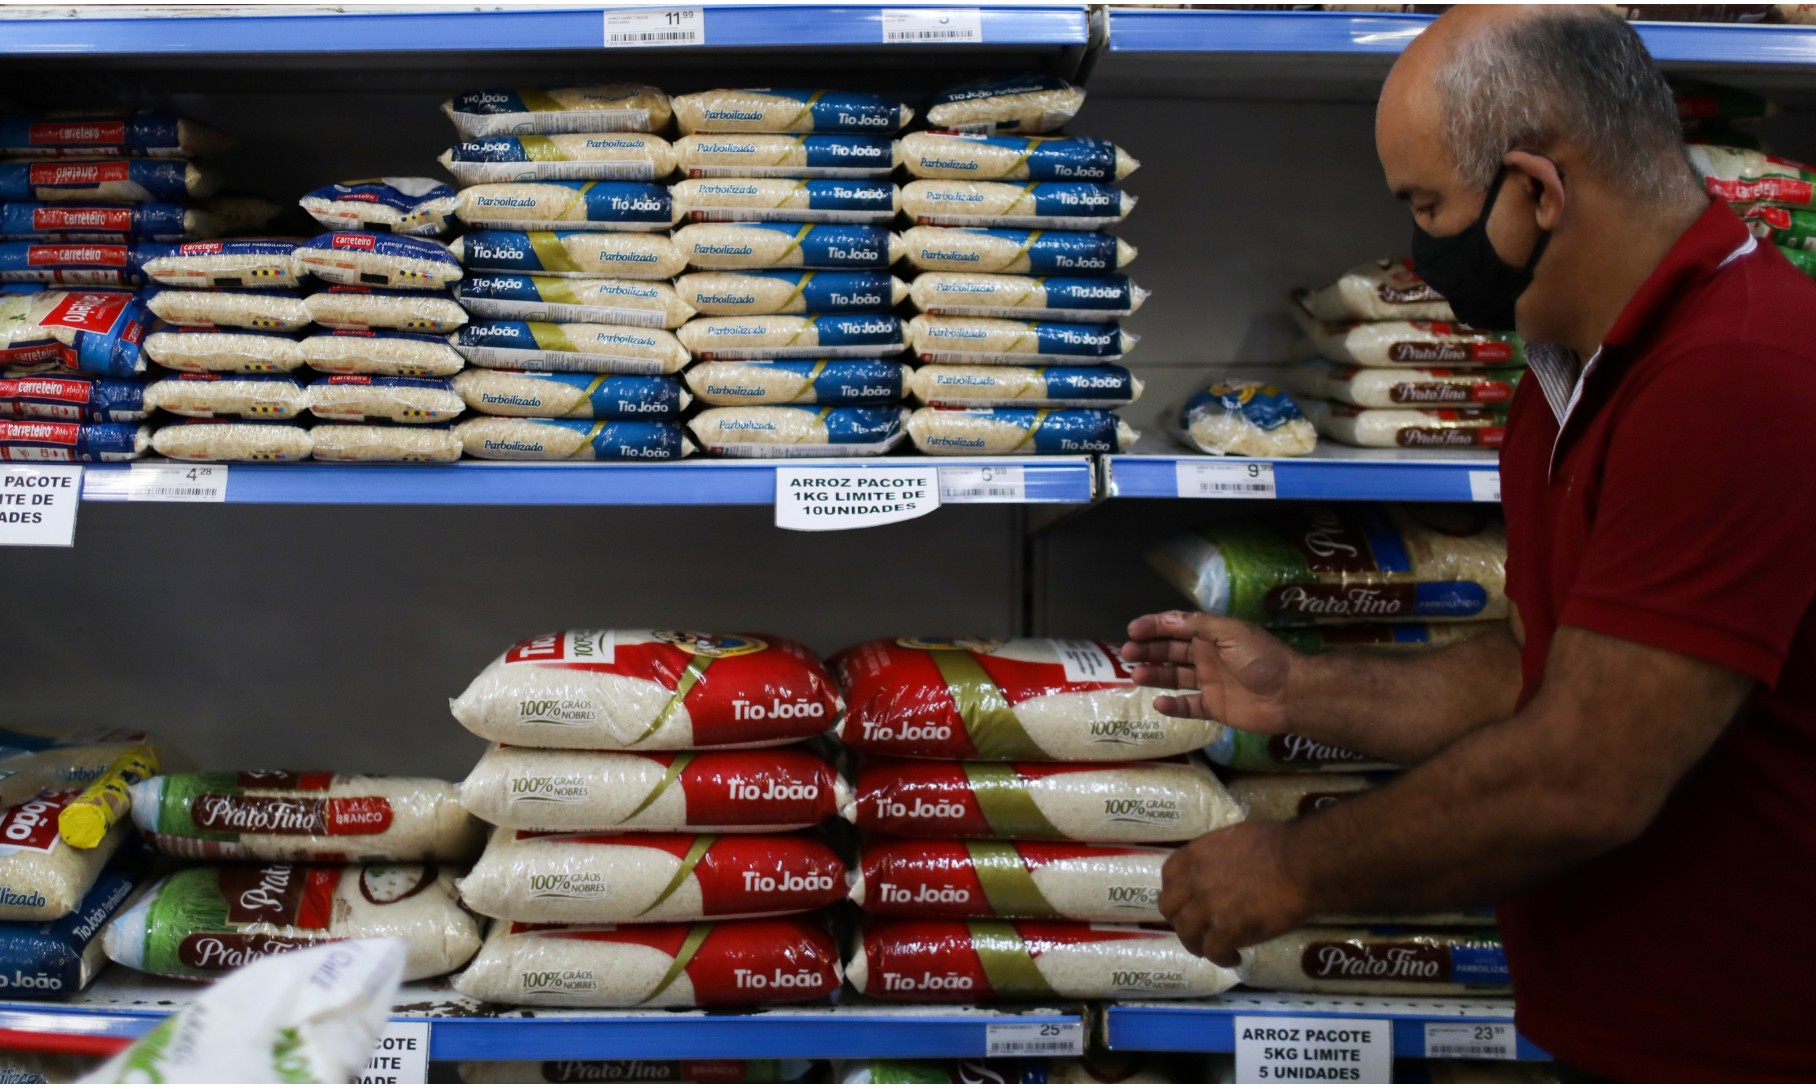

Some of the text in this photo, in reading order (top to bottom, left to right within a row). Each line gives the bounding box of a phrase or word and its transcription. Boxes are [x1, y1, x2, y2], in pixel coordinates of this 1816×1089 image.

[948, 93, 965, 101] Tio
[705, 110, 888, 125] Parboilizado Tio João
[59, 128, 99, 139] carreteiro
[481, 142, 510, 151] João
[586, 140, 644, 148] Parboilizado
[697, 144, 881, 156] Parboilizado Tio João
[920, 158, 1104, 177] Parboilizado Tio João
[699, 185, 884, 199] Parboilizado Tio João
[927, 192, 1109, 205] Parboilizado Tio João
[478, 197, 661, 211] Parboilizado Tio João
[64, 214, 105, 225] carreteiro
[184, 242, 219, 250] carreteiro
[336, 236, 371, 245] carreteiro
[59, 248, 101, 260] carreteiro
[474, 247, 658, 263] Tio João Parboilizado
[694, 244, 878, 260] Parboilizado Tio João
[921, 250, 1105, 268] Parboilizado Tio João
[472, 279, 658, 297] Tio João Parboilizado
[936, 283, 1121, 298] Parboilizado Tio João
[696, 294, 880, 304] Parboilizado Tio João
[708, 322, 893, 335] Parboilizado Tio João
[929, 328, 1081, 343] Parboilizado Tio
[470, 326, 655, 346] Tio João Parboilizado
[14, 349, 58, 361] carreteiro
[1398, 344, 1465, 360] Prato Fino
[18, 382, 62, 395] carreteiro
[937, 376, 1121, 388] Parboilizado Tio João
[707, 386, 891, 397] Parboilizado Tio João
[1398, 385, 1466, 400] Prato Fino
[482, 394, 668, 413] Parboilizado Tio João
[7, 424, 51, 437] carreteiro
[1405, 429, 1472, 443] Prato Fino
[484, 440, 670, 458] Parboilizado Tio João
[927, 437, 1110, 451] Parboilizado Tio João
[982, 468, 992, 482] 6
[1248, 464, 1258, 477] 9
[5, 477, 72, 487] PACOTE
[790, 478, 927, 487] ARROZ PACOTE
[32, 495, 54, 505] DE
[793, 491, 926, 501] 1KG LIMITE DE
[803, 503, 916, 515] 10UNIDADES
[1280, 586, 1401, 613] Prato Fino
[520, 699, 592, 717] 100% GRÃOS
[562, 710, 596, 720] NOBRES
[732, 699, 823, 720] Tio João
[863, 721, 951, 741] Tio João
[1090, 720, 1129, 736] 100%
[1131, 731, 1164, 740] NOBRES
[512, 778, 553, 793] 100%
[554, 788, 588, 796] NOBRES
[727, 779, 818, 800] Tio João
[204, 798, 382, 830] Prato Fino BRANCO
[876, 799, 965, 818] Tio João
[1105, 799, 1144, 816] 100%
[1146, 810, 1180, 819] NOBRES
[529, 873, 601, 890] 100% GRÃOS
[572, 883, 605, 892] NOBRES
[742, 871, 833, 891] Tio João
[880, 884, 969, 902] Tio João
[1108, 886, 1147, 902] 100%
[1317, 947, 1438, 977] Prato Fino
[10, 972, 62, 990] João
[522, 970, 594, 987] 100% GRÃOS
[563, 980, 597, 990] NOBRES
[735, 969, 822, 988] Tio João
[883, 973, 973, 990] Tio João
[1112, 971, 1152, 986] 100%
[1040, 1024, 1061, 1036] 25
[1242, 1029, 1371, 1043] ARROZ PACOTE
[1474, 1027, 1493, 1040] 23
[1264, 1048, 1360, 1062] 5KG LIMITE
[557, 1060, 621, 1080] Prato
[1259, 1067, 1360, 1080] 5 UNIDADES
